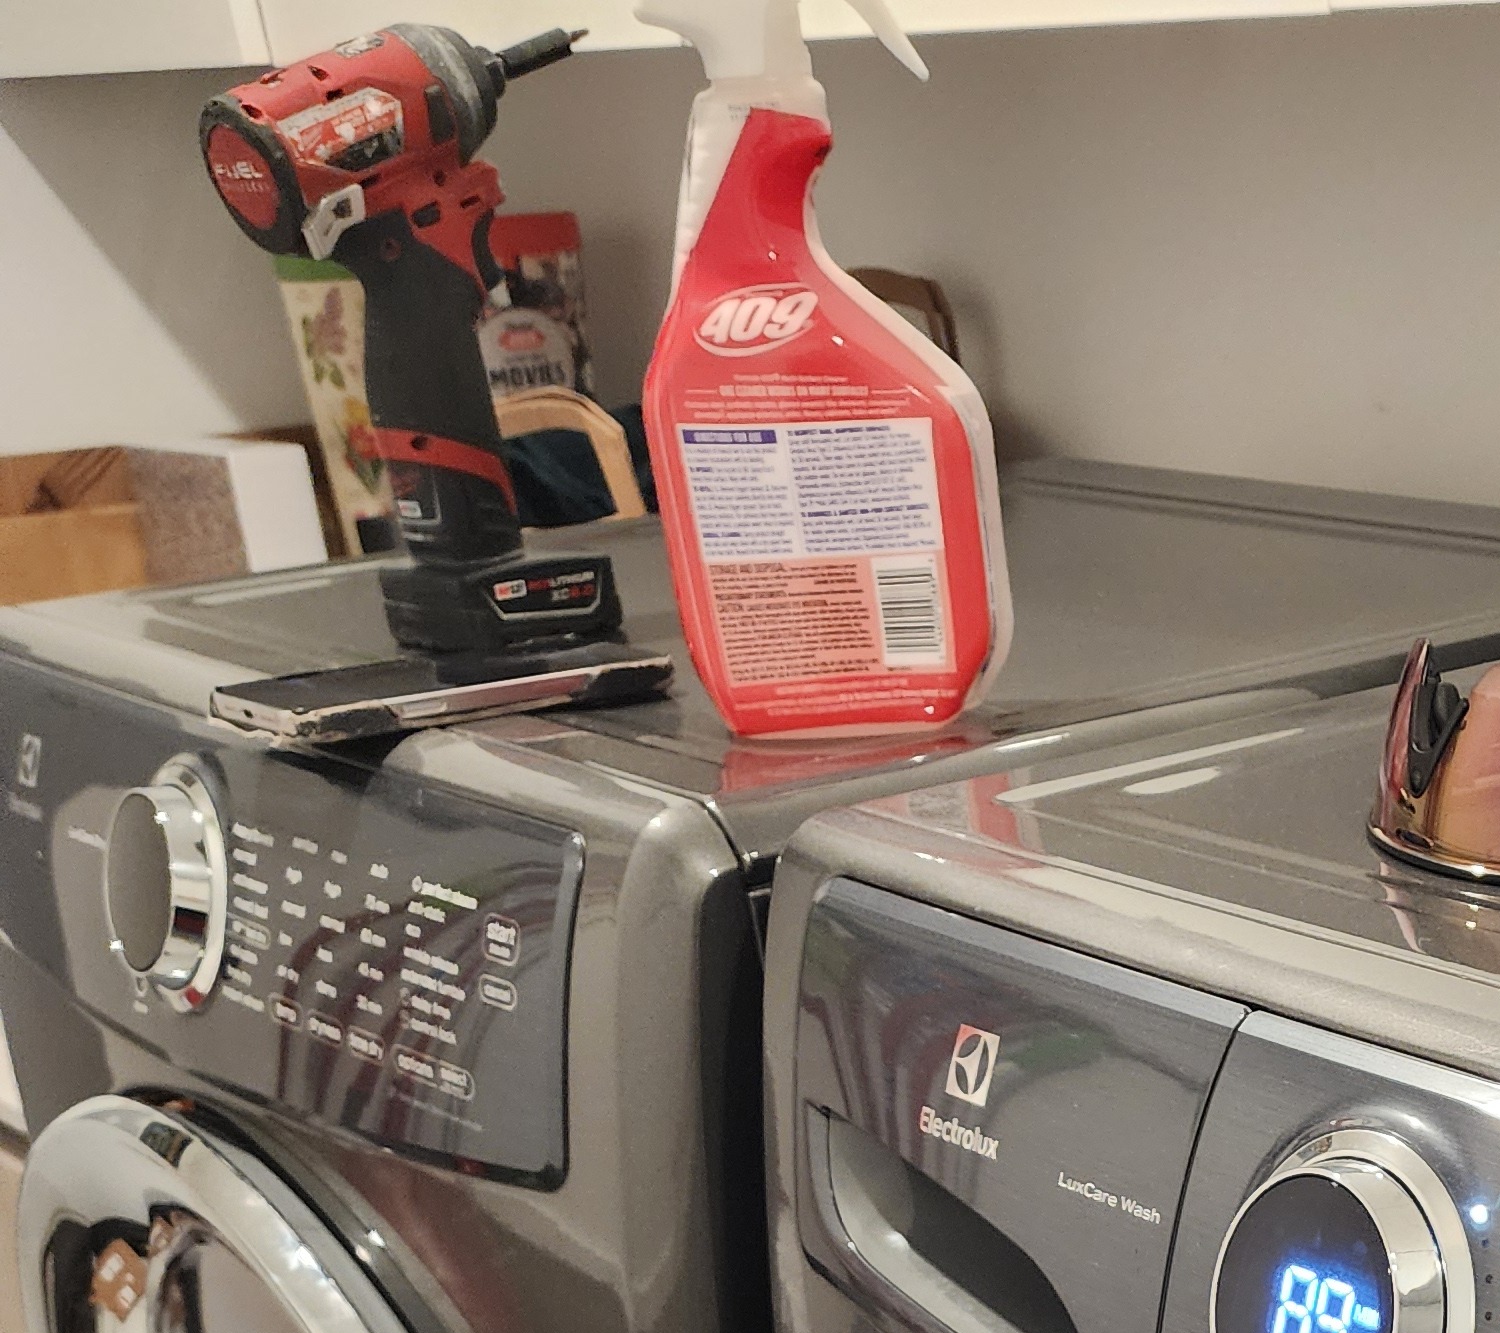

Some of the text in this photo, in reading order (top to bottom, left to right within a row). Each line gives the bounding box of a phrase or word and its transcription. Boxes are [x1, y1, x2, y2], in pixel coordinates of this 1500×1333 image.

[699, 290, 819, 344] 409
[919, 1105, 999, 1160] Electrolux
[1057, 1171, 1161, 1225] LuxCare Wash
